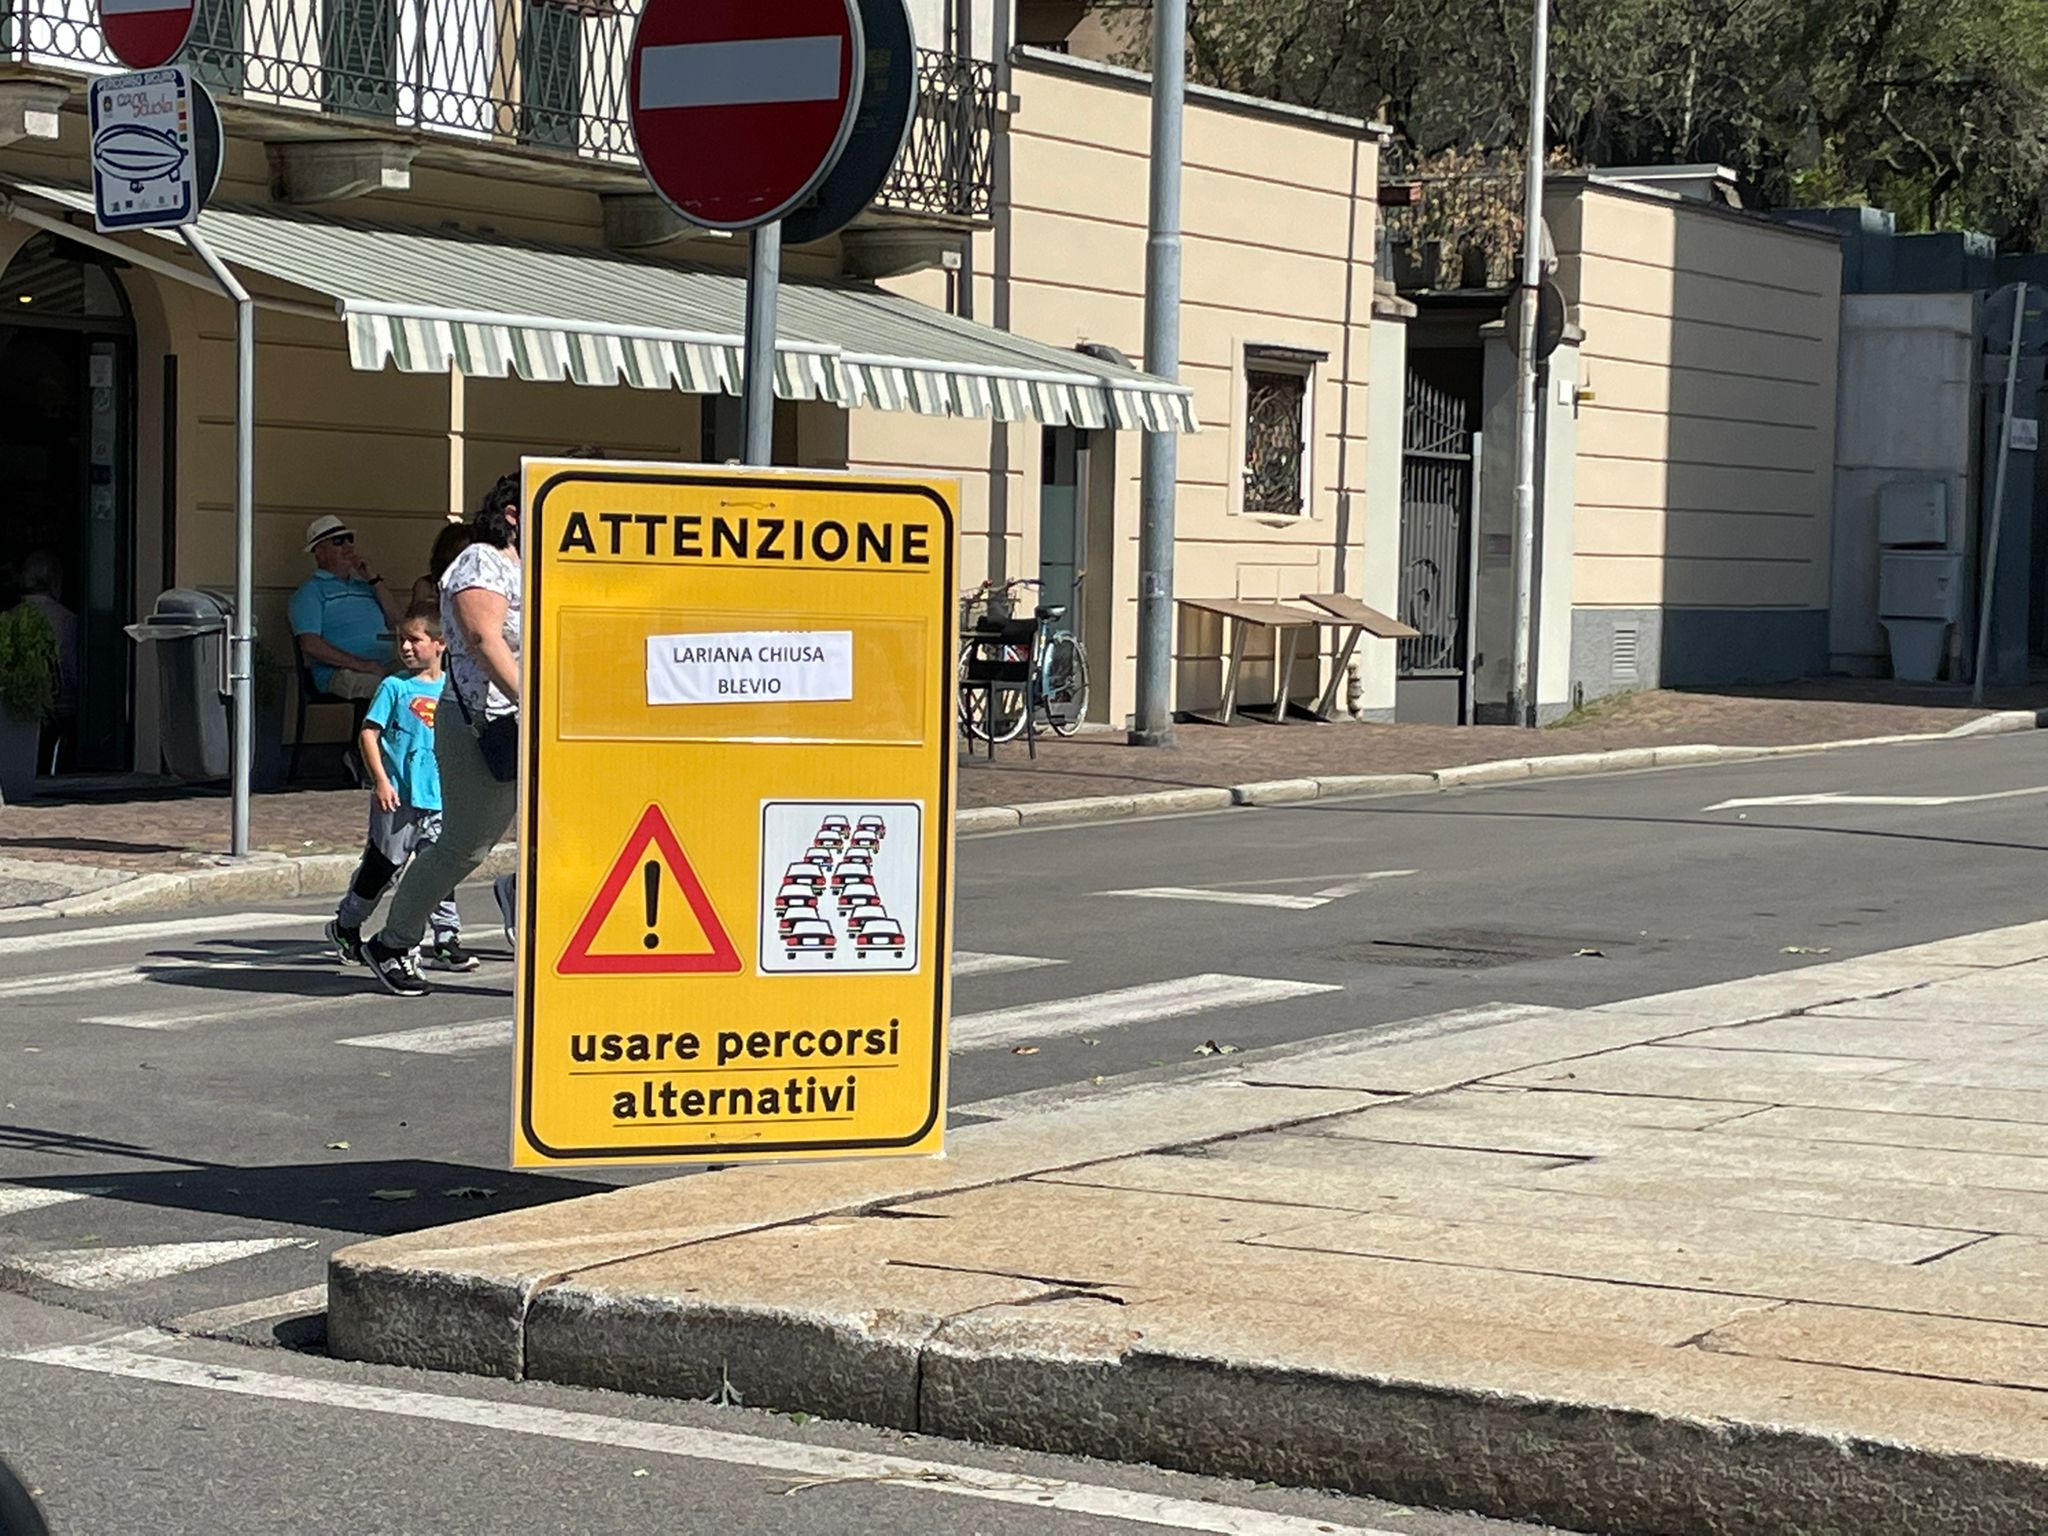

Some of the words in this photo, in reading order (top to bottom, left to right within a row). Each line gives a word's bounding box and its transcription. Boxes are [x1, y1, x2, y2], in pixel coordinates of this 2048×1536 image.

[558, 512, 930, 564] ATTENZIONE
[673, 647, 753, 663] LARIANA
[758, 646, 825, 662] CHIUSA
[718, 678, 781, 694] BLEVIO
[570, 1033, 700, 1063] usare
[717, 1018, 899, 1066] percorsi
[612, 1075, 856, 1119] alternativi
